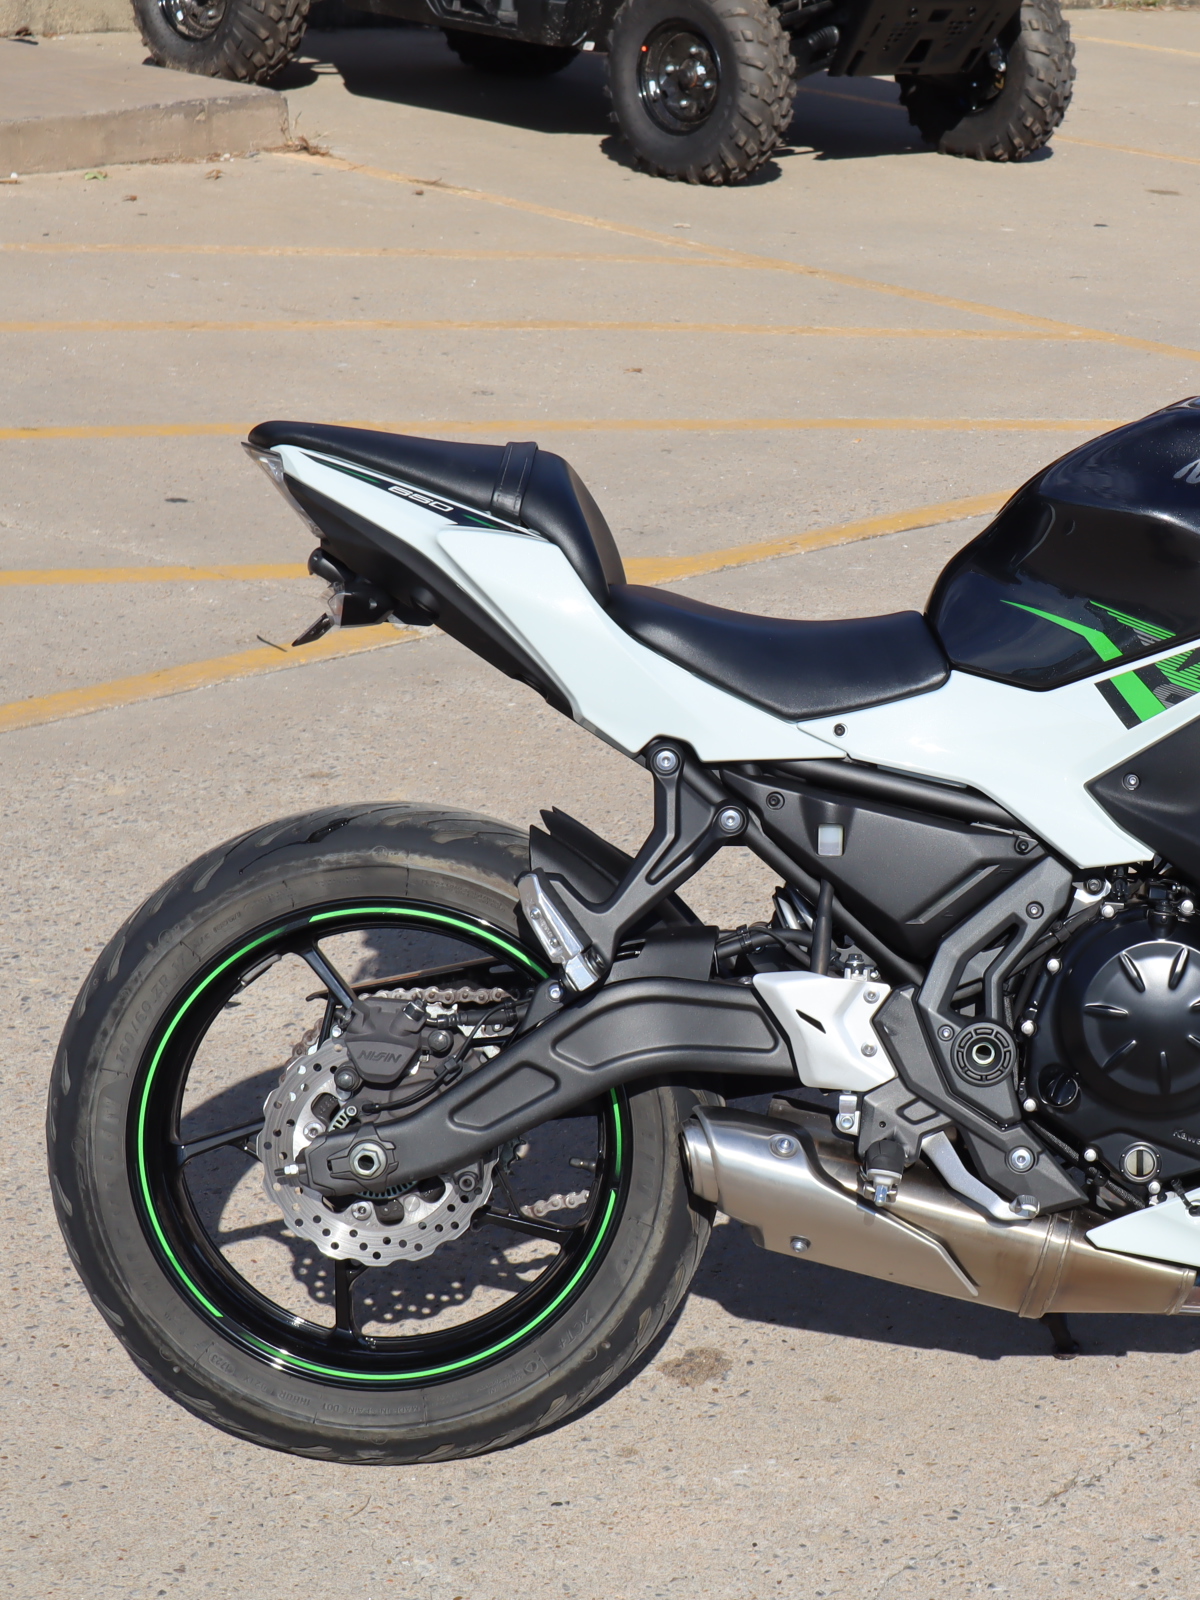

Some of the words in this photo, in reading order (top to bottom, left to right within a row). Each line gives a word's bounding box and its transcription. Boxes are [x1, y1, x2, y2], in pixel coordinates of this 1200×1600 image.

[387, 485, 454, 512] 650
[208, 1353, 231, 1372] 1723
[320, 1401, 340, 1413] DOT
